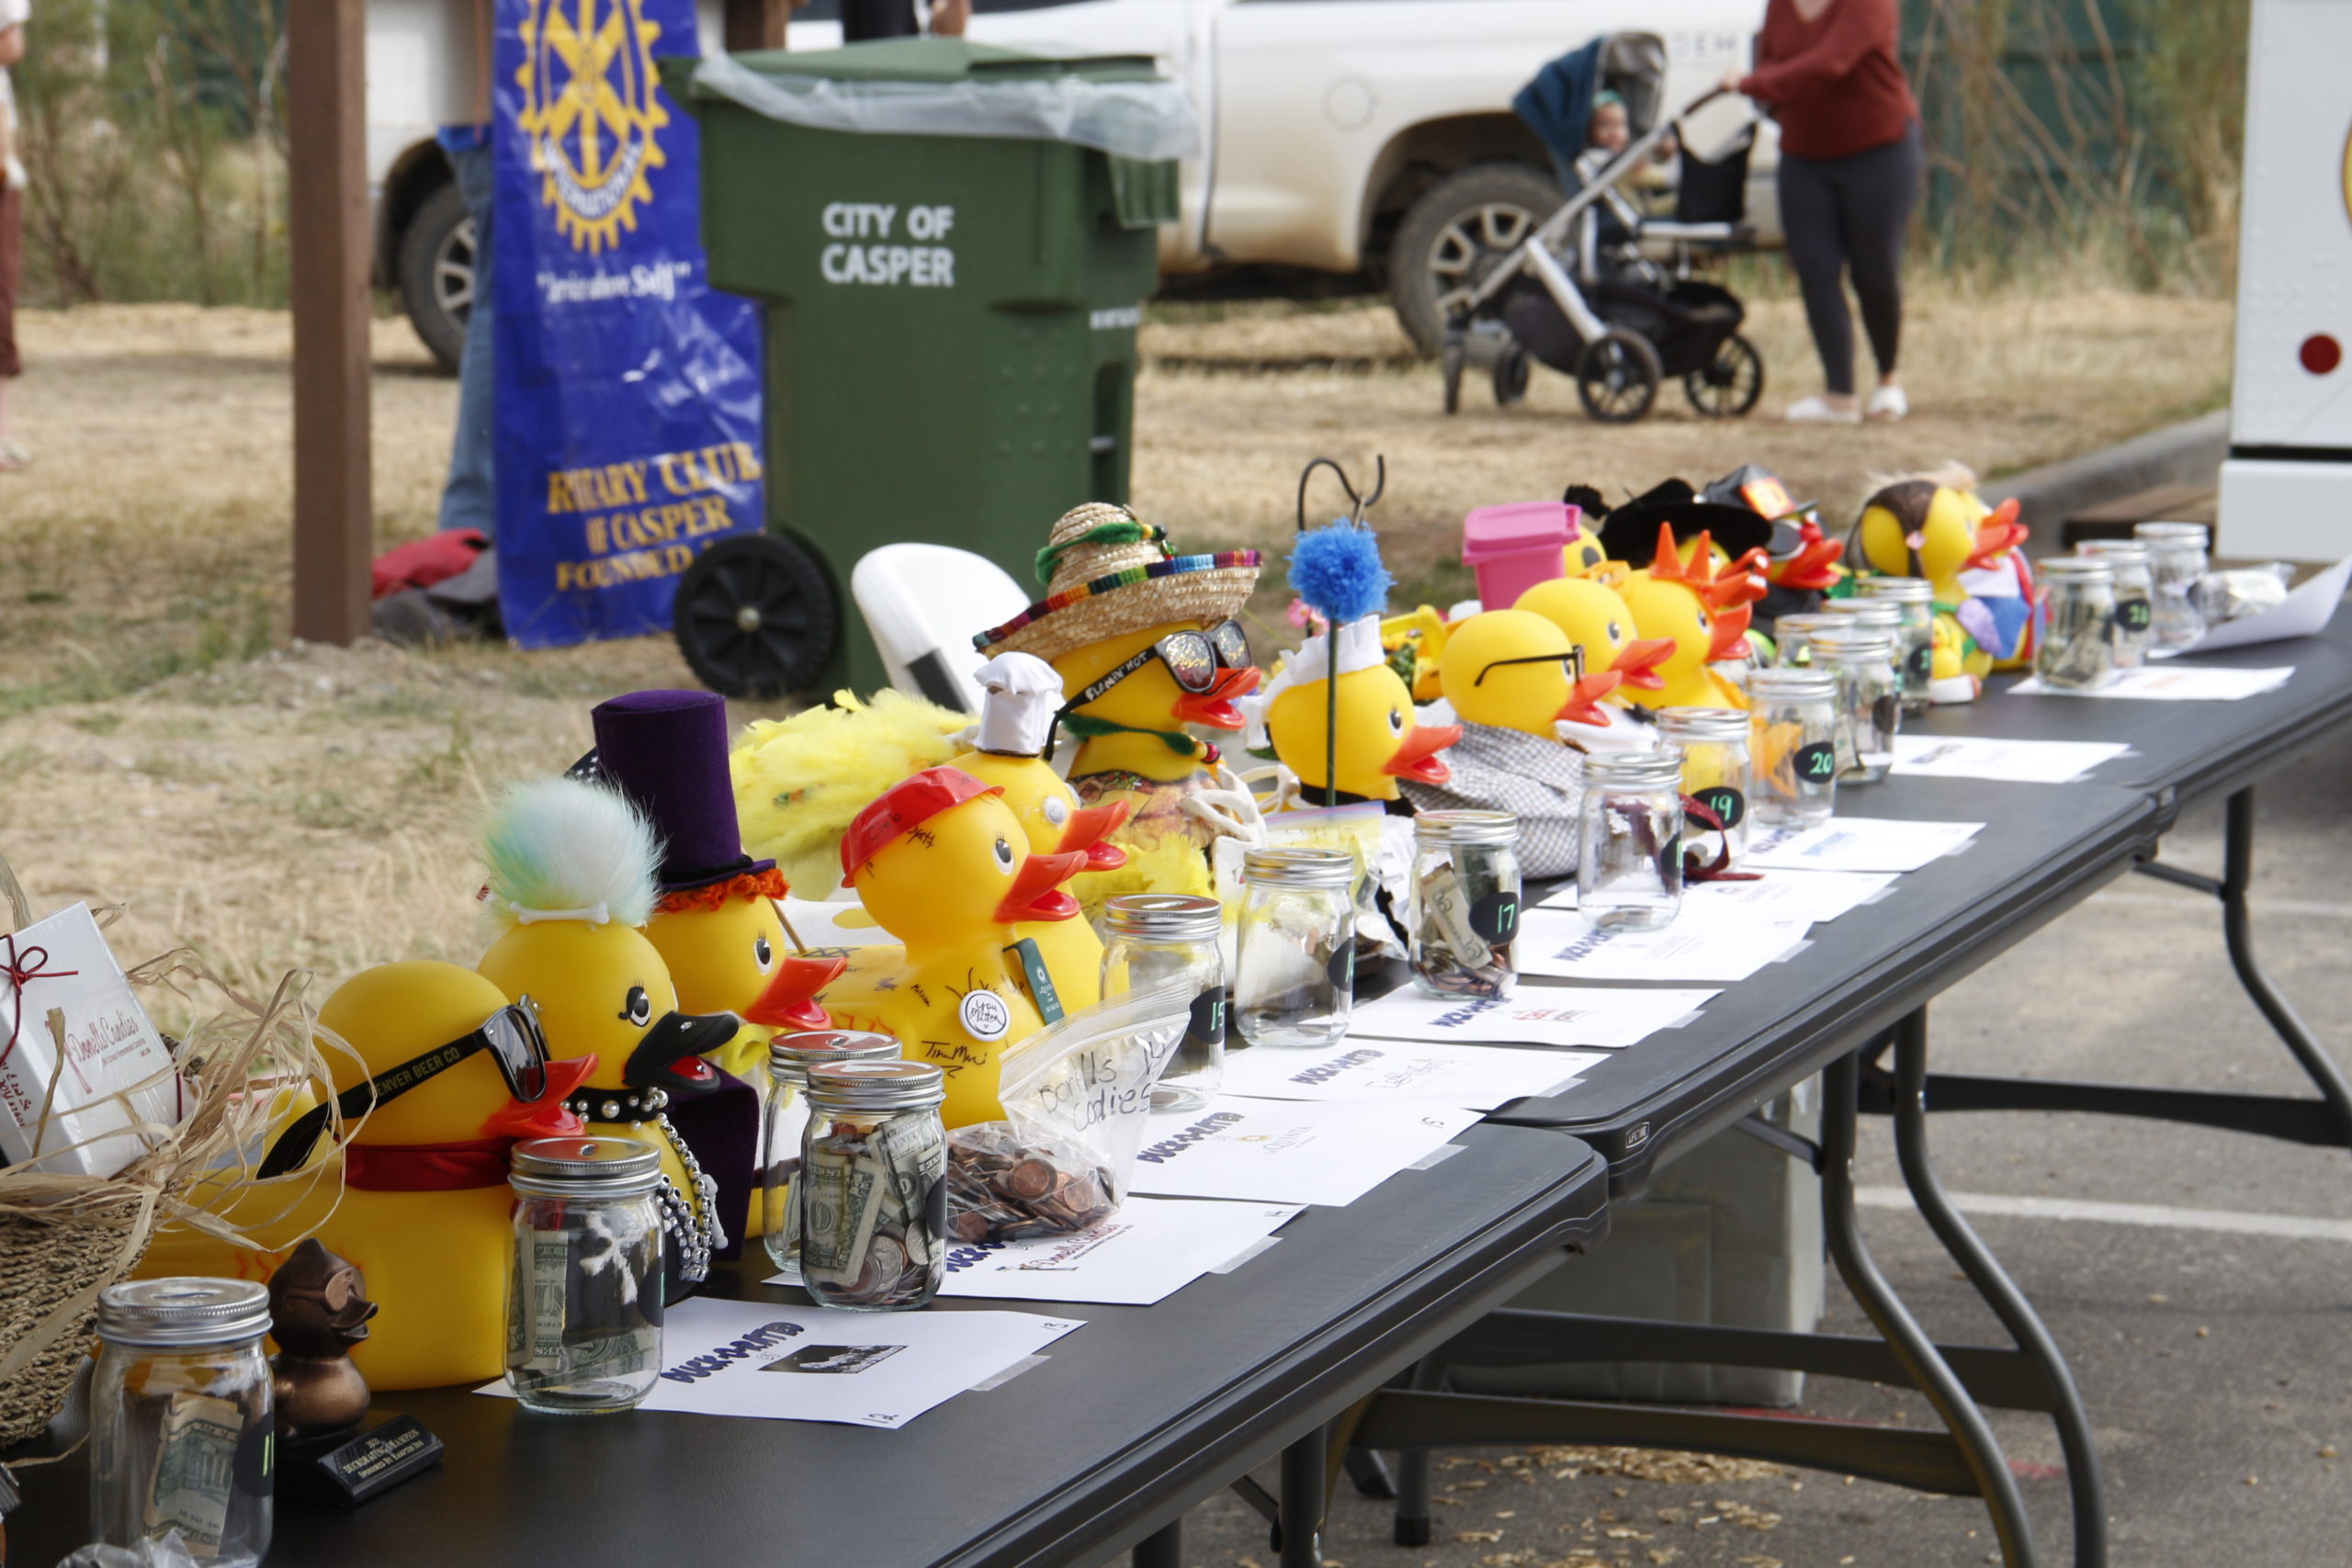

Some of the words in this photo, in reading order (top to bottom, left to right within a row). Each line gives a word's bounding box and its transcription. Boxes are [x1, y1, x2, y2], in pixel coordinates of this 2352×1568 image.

[822, 202, 896, 239] CITY
[906, 206, 955, 240] OF
[820, 244, 955, 287] CASPER
[657, 442, 762, 496] CLUB
[611, 495, 734, 549] CASPER
[1809, 751, 1833, 774] 20
[1711, 795, 1733, 821] 19
[1498, 903, 1516, 933] 17
[1210, 1001, 1225, 1032] 15
[413, 1055, 443, 1078] BEER
[661, 1321, 806, 1384] DUCK-O-RATED
